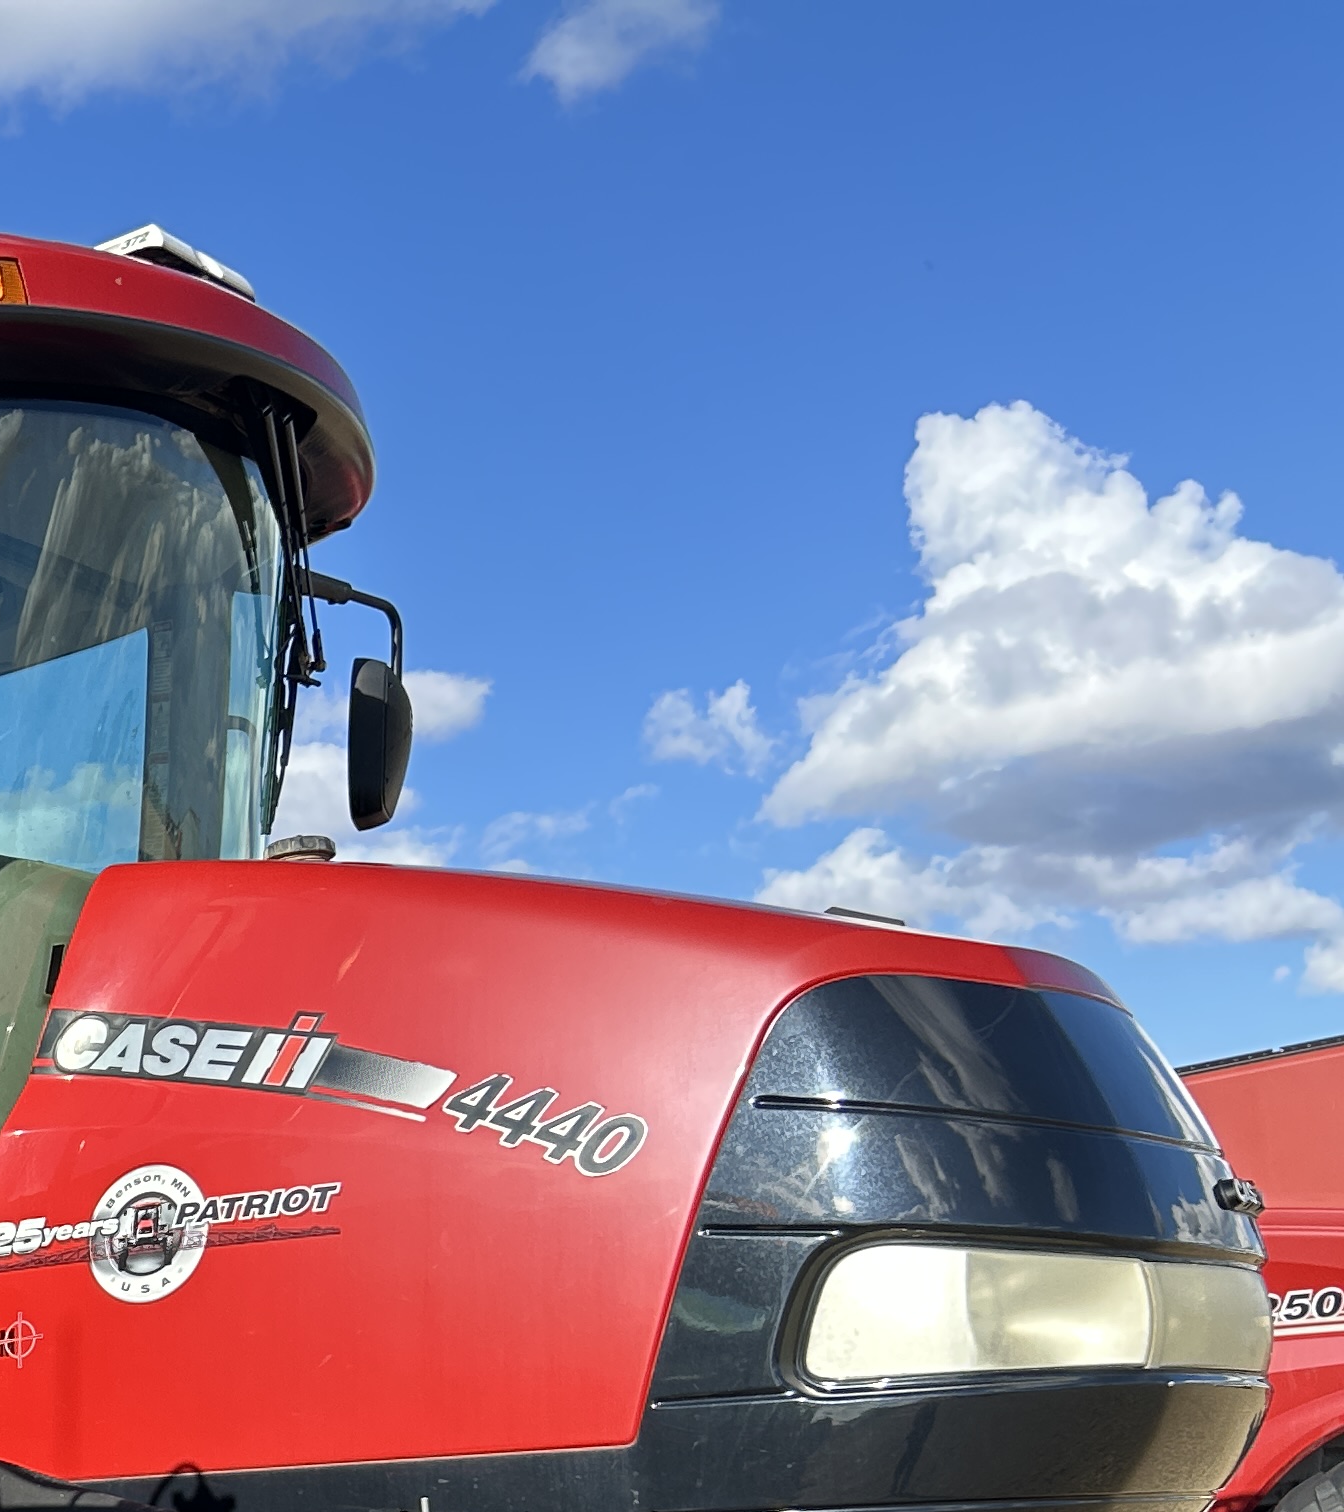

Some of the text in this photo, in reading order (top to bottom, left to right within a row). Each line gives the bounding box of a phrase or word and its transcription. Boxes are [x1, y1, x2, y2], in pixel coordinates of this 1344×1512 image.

[121, 231, 150, 251] 372
[55, 1014, 249, 1082] CASE
[444, 1073, 647, 1177] 4440
[105, 1173, 191, 1209] Benson, MN
[175, 1181, 342, 1229] PATRIOT
